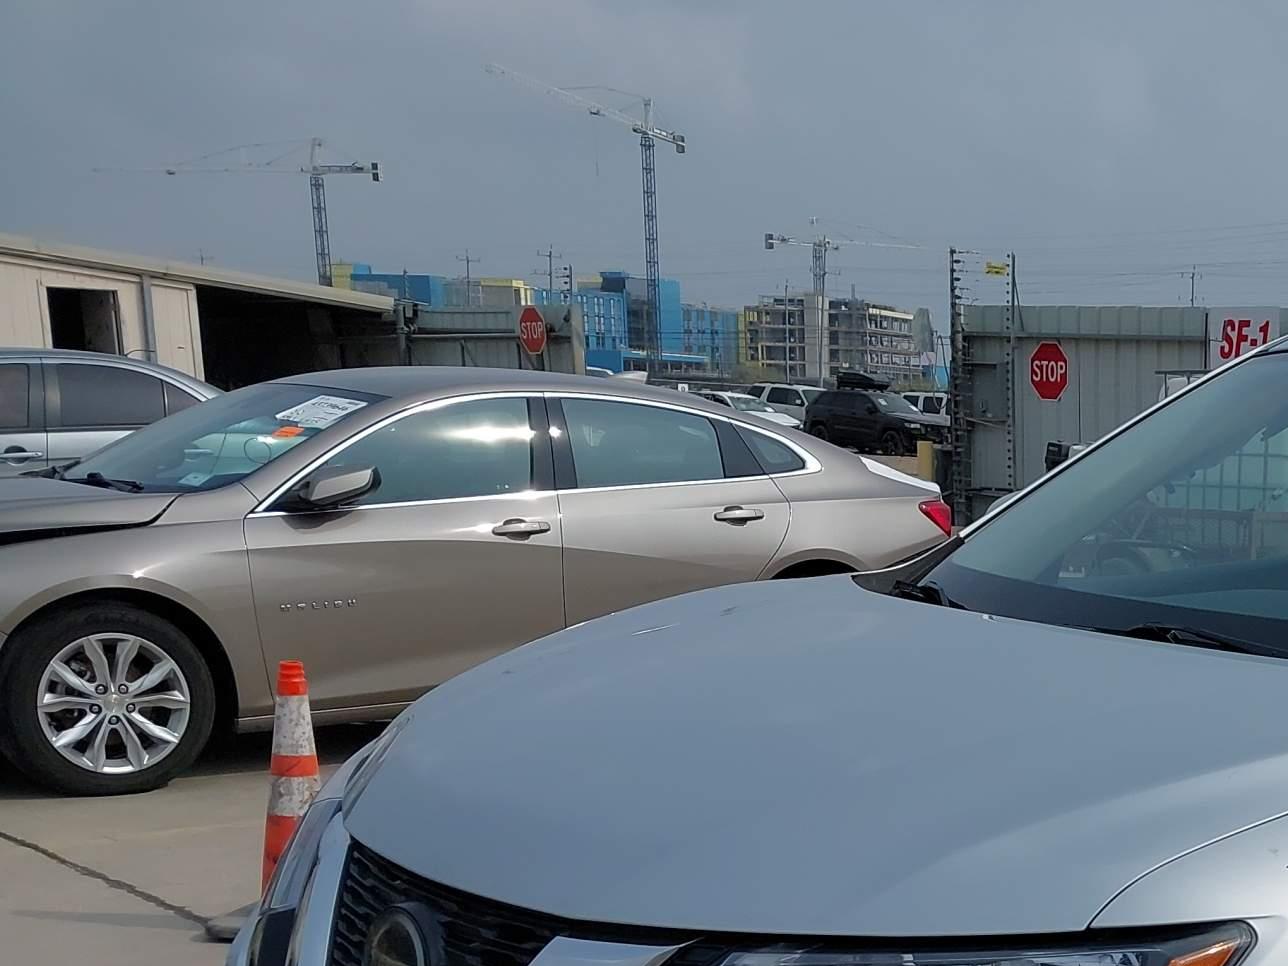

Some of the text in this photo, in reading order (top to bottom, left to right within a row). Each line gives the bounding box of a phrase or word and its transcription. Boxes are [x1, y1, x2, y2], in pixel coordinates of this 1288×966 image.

[521, 321, 543, 339] STOP
[1219, 319, 1270, 359] SF-1
[1032, 360, 1066, 382] STOP
